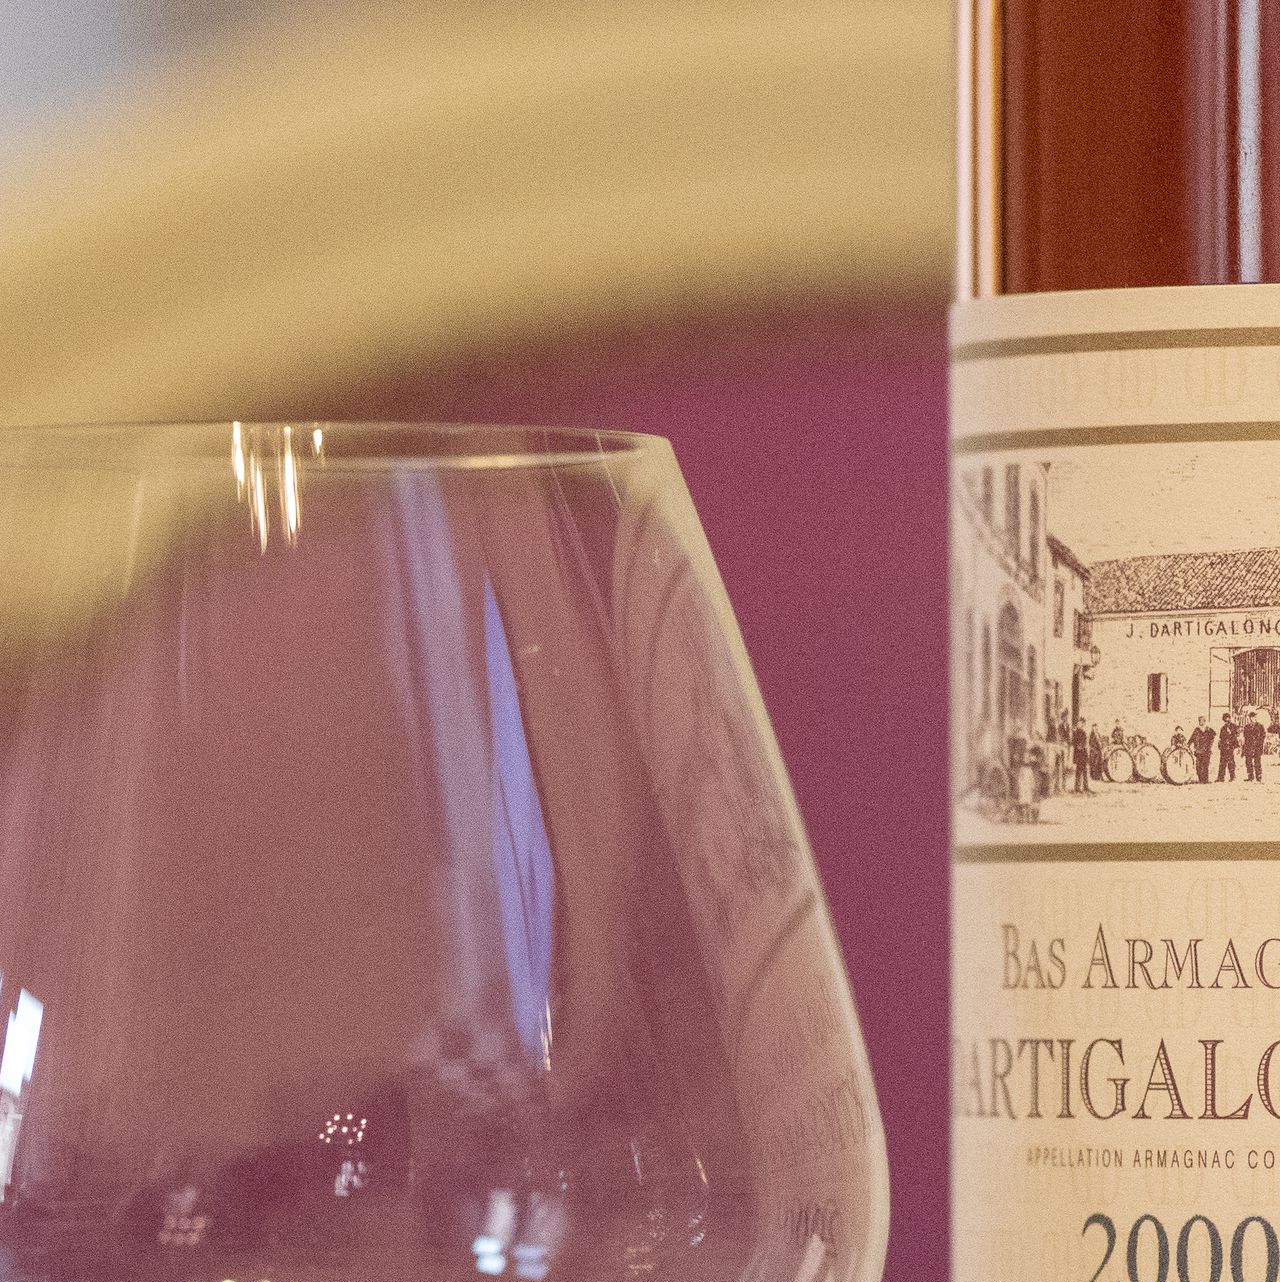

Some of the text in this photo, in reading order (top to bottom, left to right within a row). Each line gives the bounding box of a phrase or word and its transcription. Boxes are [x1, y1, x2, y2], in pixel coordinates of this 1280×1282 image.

[1126, 622, 1143, 639] J.
[1001, 923, 1067, 990] BAS
[1026, 1148, 1123, 1169] APPELLATION
[1132, 1149, 1236, 1169] ARMAGNAC
